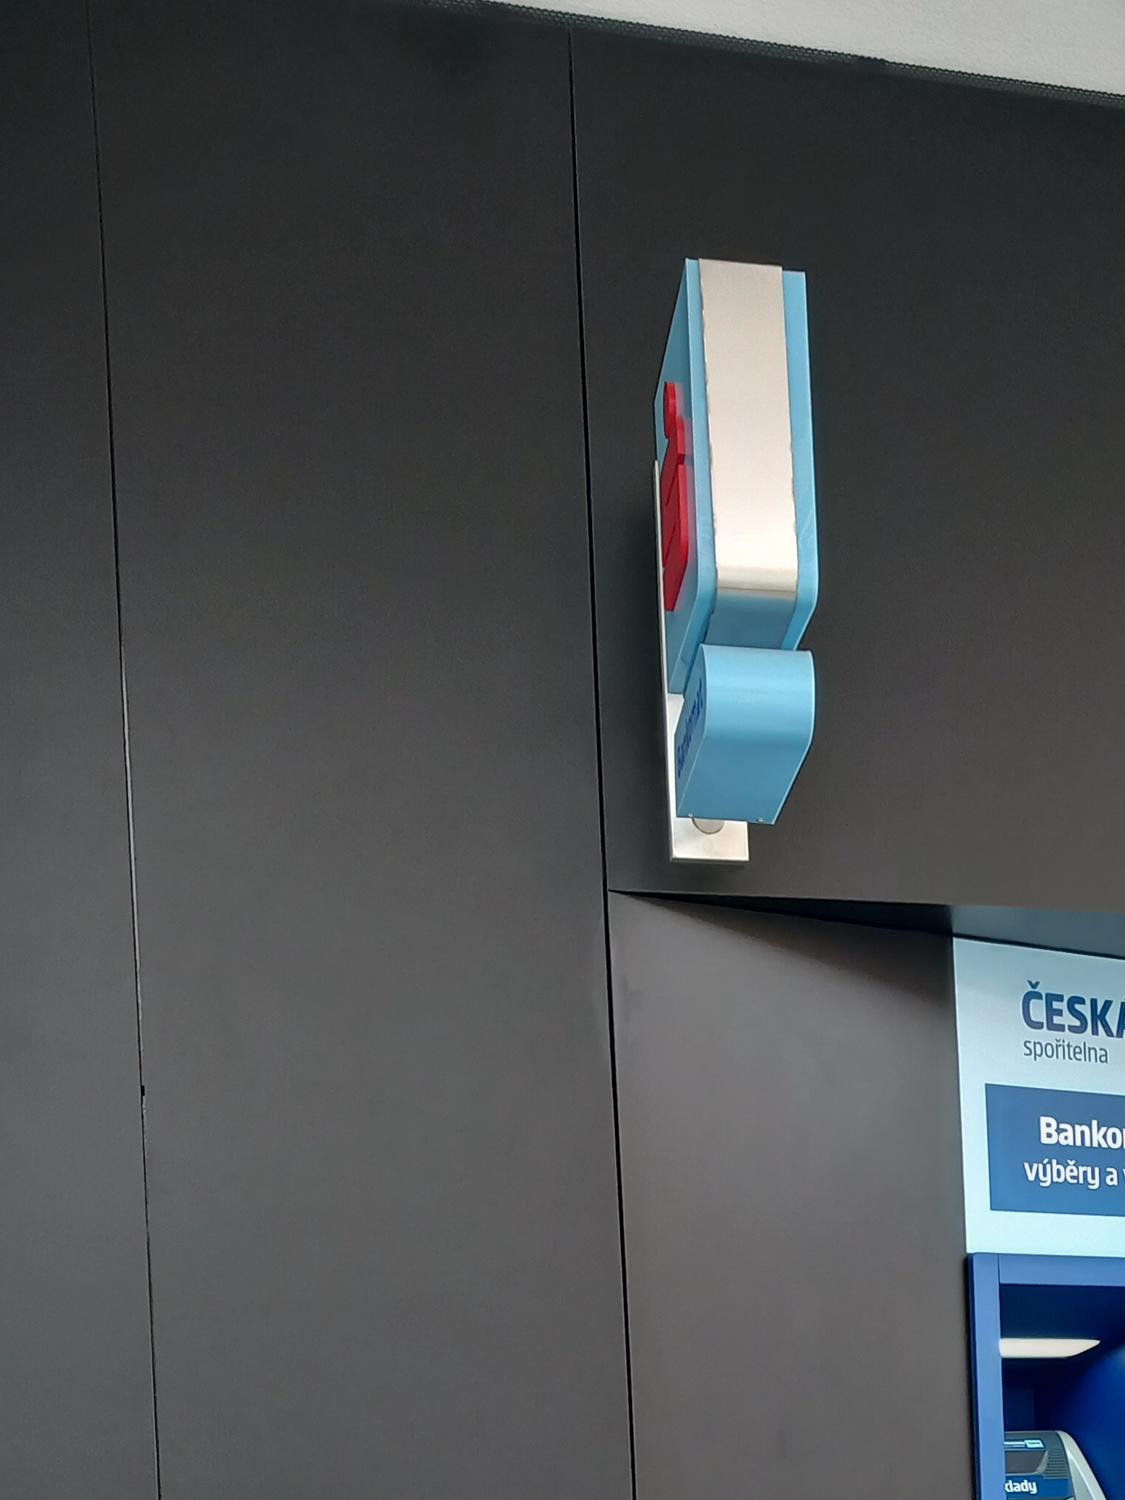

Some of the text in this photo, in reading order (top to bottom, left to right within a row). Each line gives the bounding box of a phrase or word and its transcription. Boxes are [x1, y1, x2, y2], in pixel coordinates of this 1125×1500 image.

[1023, 1039, 1108, 1064] spořitelna
[1023, 1158, 1100, 1190] výběry
[1105, 1166, 1119, 1187] a
